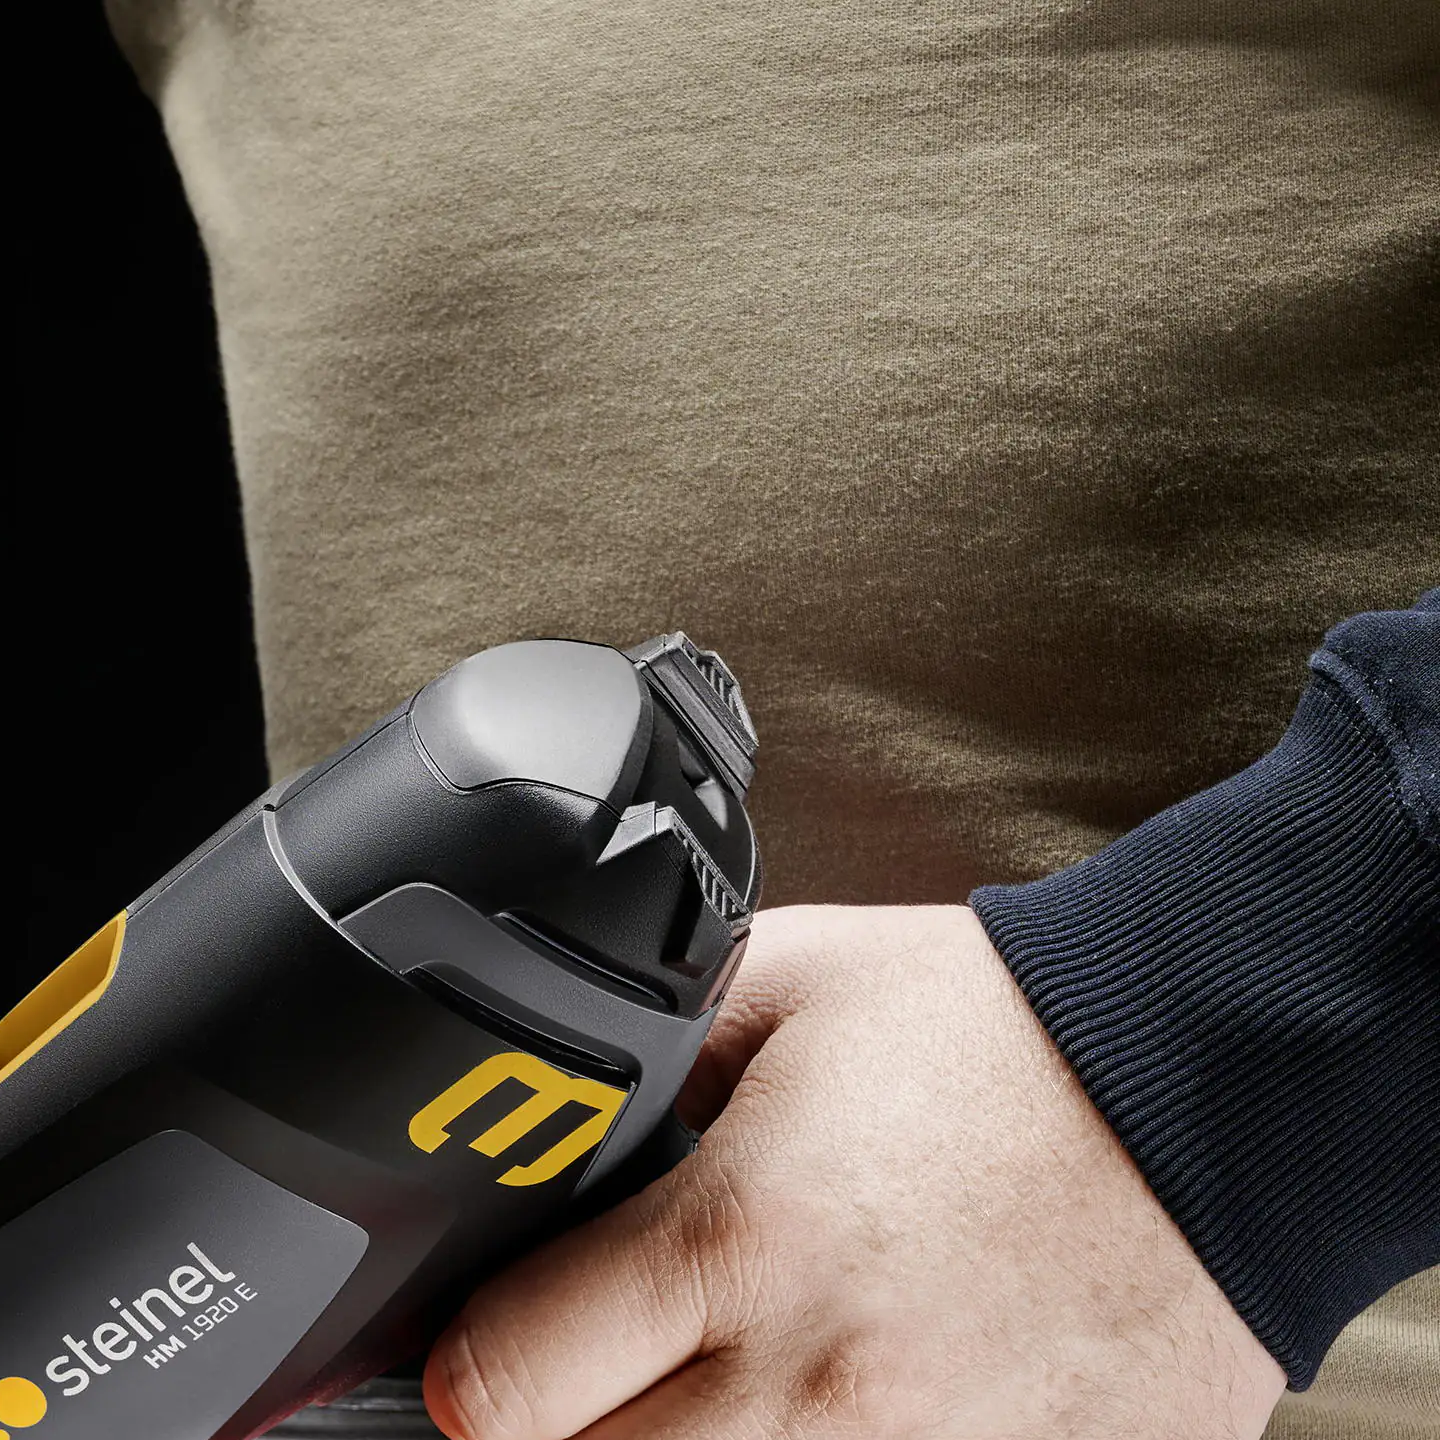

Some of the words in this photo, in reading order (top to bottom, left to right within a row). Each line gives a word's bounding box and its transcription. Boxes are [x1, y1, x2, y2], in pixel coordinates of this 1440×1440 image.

[45, 1241, 236, 1397] steinel
[143, 1334, 187, 1369] HM
[182, 1294, 240, 1341] 1920
[234, 1282, 259, 1302] E
